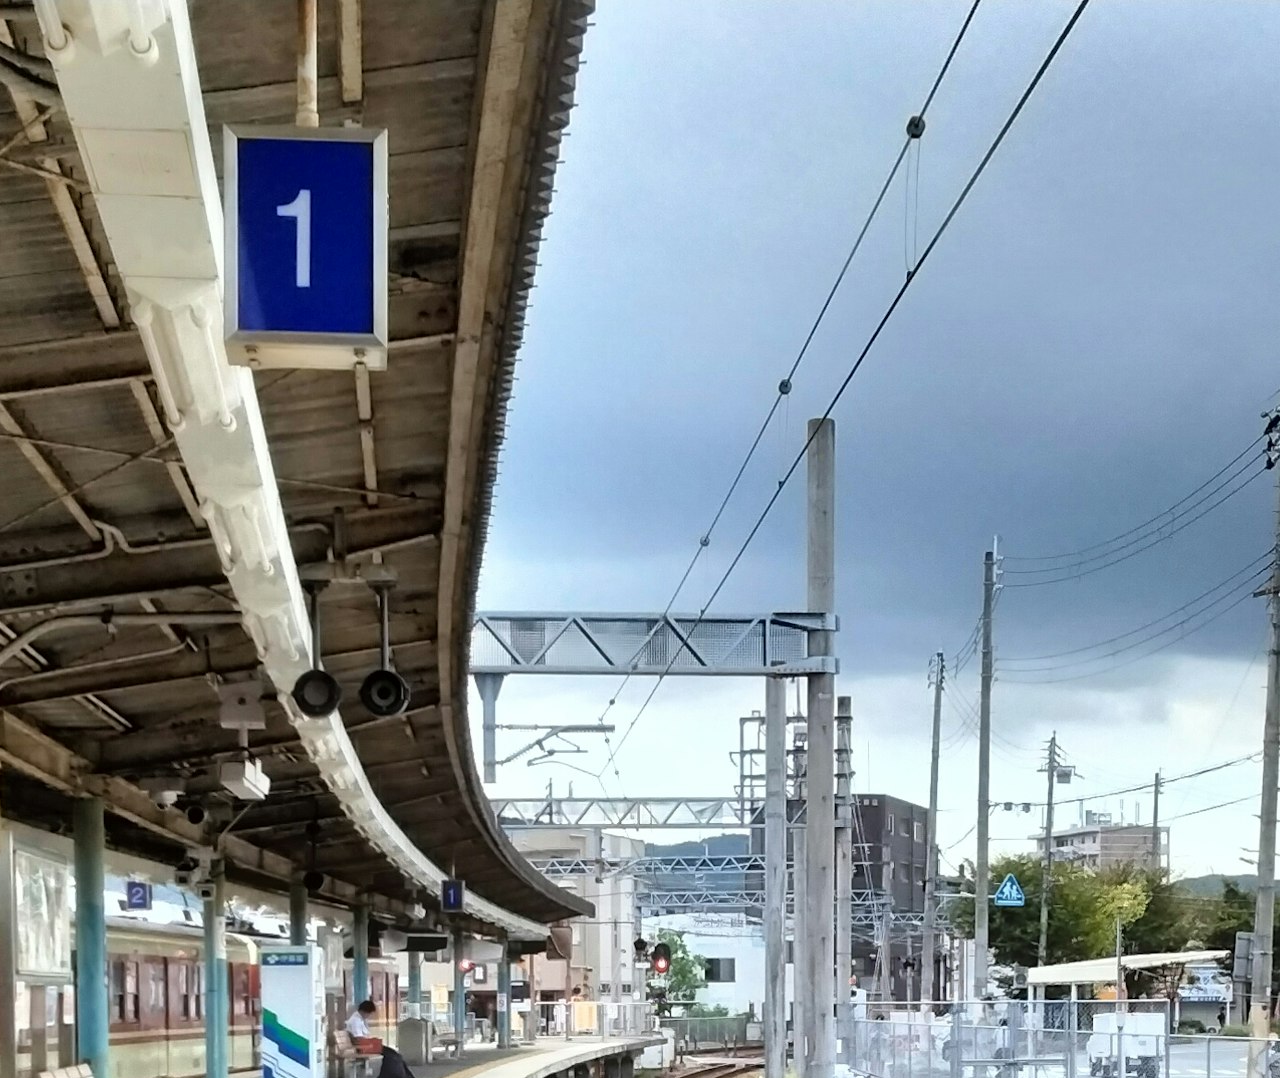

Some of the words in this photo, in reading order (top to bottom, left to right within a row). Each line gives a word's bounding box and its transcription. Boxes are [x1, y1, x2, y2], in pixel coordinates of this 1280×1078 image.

[277, 189, 311, 288] 1
[131, 886, 144, 903] 2
[448, 888, 455, 904] 1
